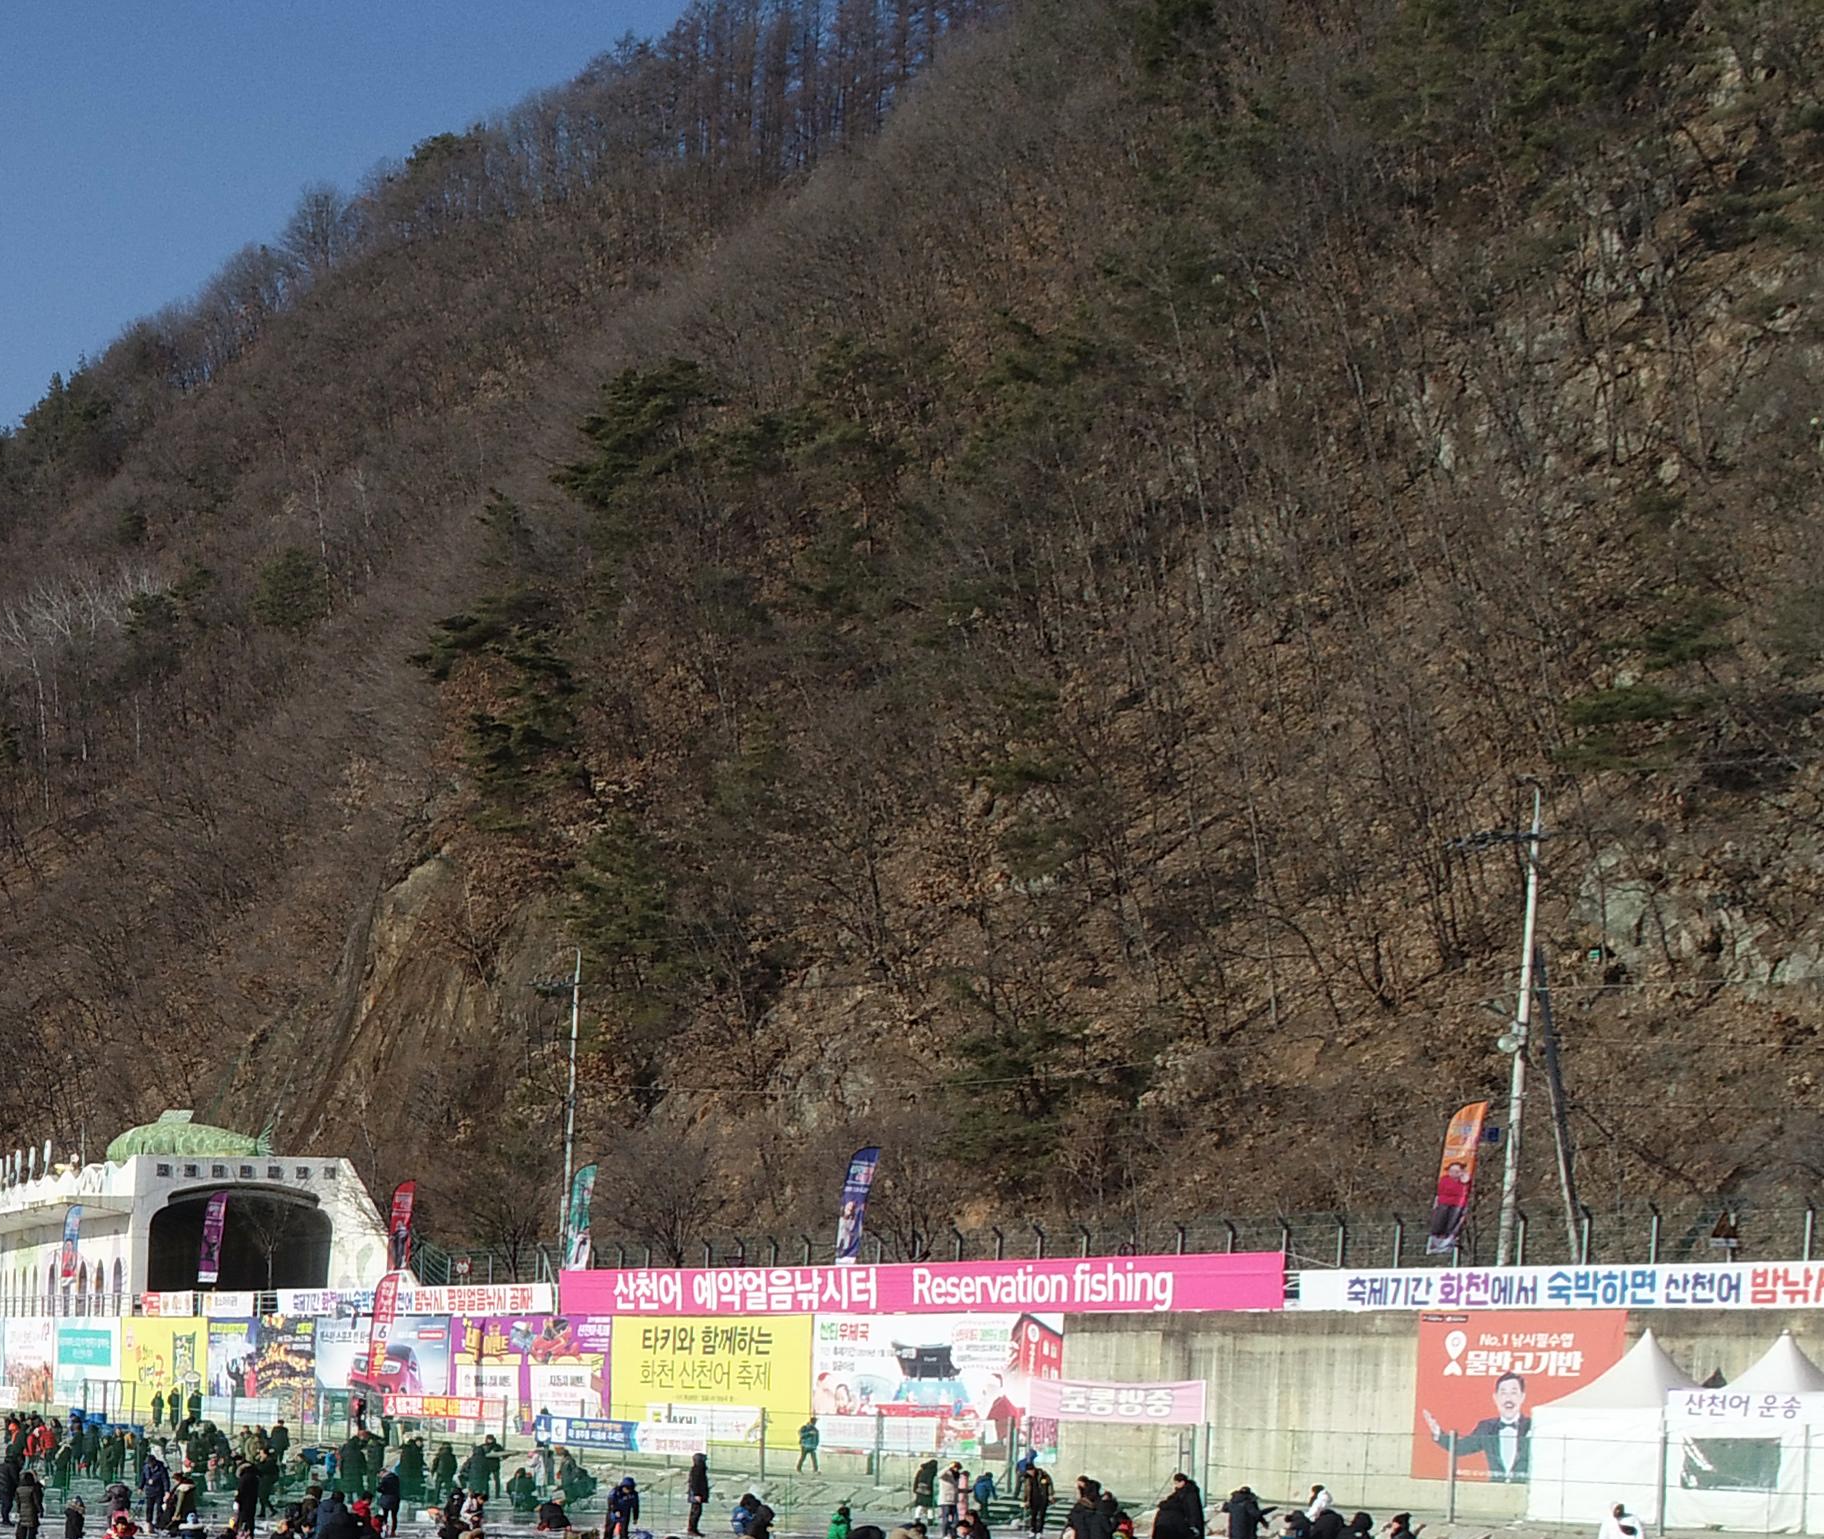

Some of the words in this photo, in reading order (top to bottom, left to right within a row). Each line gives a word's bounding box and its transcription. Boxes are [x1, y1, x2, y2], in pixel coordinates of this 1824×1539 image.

[613, 1271, 683, 1312] 산천어
[692, 1267, 878, 1312] 예약얼음낚시터
[912, 1264, 1068, 1305] Reservation
[1072, 1262, 1174, 1312] fishing
[1347, 1275, 1433, 1306] 축제기간
[1438, 1271, 1538, 1306] 화천에서
[1547, 1269, 1657, 1306] 숙박하면
[1664, 1272, 1742, 1304] 산천어
[378, 1325, 387, 1339] 6
[642, 1325, 695, 1355] 타키와
[701, 1325, 774, 1355] 함께하는
[1479, 1333, 1508, 1347] No.1
[640, 1360, 674, 1389] 화천
[678, 1360, 731, 1390] 산천어
[736, 1360, 772, 1391] 축제
[1465, 1349, 1585, 1377] 물반고기반
[1685, 1393, 1751, 1418] 산천어
[1758, 1394, 1802, 1420] 운송
